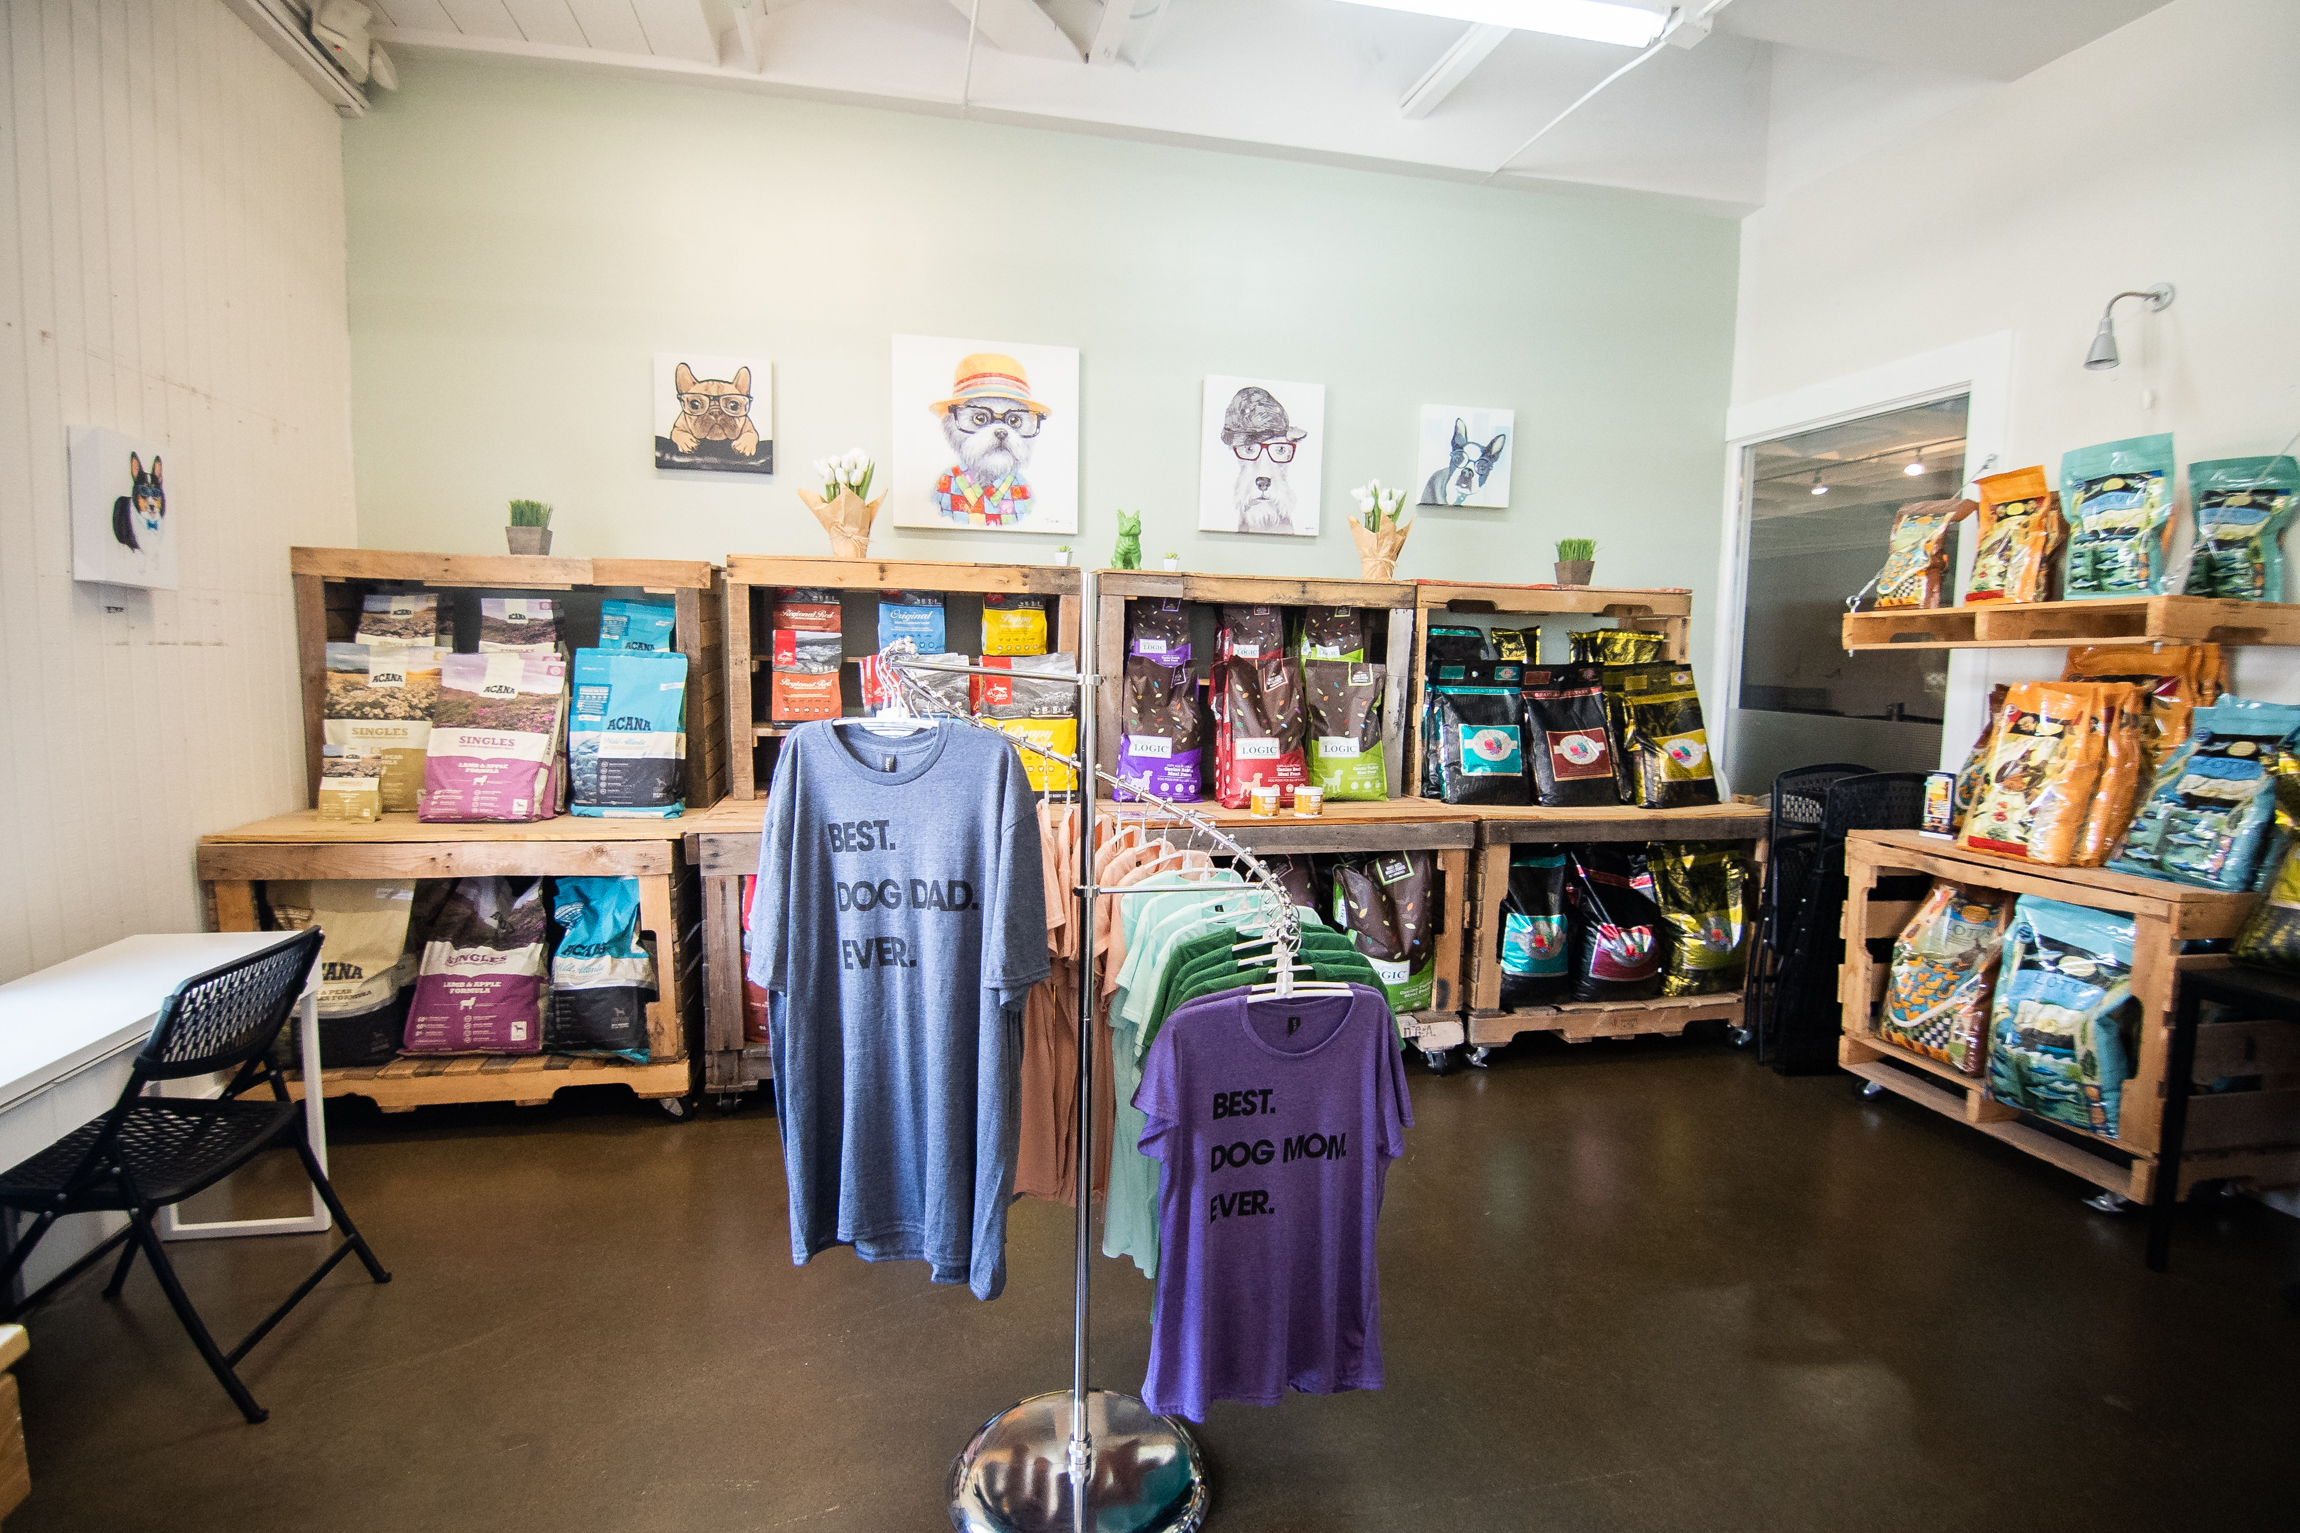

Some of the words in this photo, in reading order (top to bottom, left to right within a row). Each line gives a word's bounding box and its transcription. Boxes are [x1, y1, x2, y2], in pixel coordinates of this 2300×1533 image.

[781, 608, 816, 620] Regional
[816, 609, 835, 620] Red
[890, 608, 934, 622] Original
[1000, 613, 1032, 626] Puppy
[624, 641, 656, 652] ACANA
[1143, 644, 1165, 652] LOGIC
[1237, 648, 1258, 656] LOGIC
[371, 672, 404, 684] ACANA
[779, 677, 816, 689] Regional
[816, 678, 834, 688] Red
[482, 684, 516, 696] ACANA
[606, 716, 652, 732] ACANA
[351, 727, 409, 738] SINGLES
[459, 735, 516, 748] SINGLES
[1134, 743, 1169, 754] LOGIC
[1242, 745, 1278, 755] LOGIC
[1324, 744, 1357, 754] LOGIC
[827, 820, 896, 853] BEST.
[837, 879, 903, 912] DOG
[909, 879, 979, 912] DAD.
[446, 953, 508, 964] SINGLES
[841, 936, 917, 970] EVER.
[322, 961, 364, 981] ANA
[1377, 970, 1405, 980] GIC
[1212, 1089, 1276, 1120] BEST.
[1210, 1139, 1275, 1173] DOG
[1282, 1133, 1347, 1163] MOM.
[1210, 1190, 1275, 1225] EVER.
